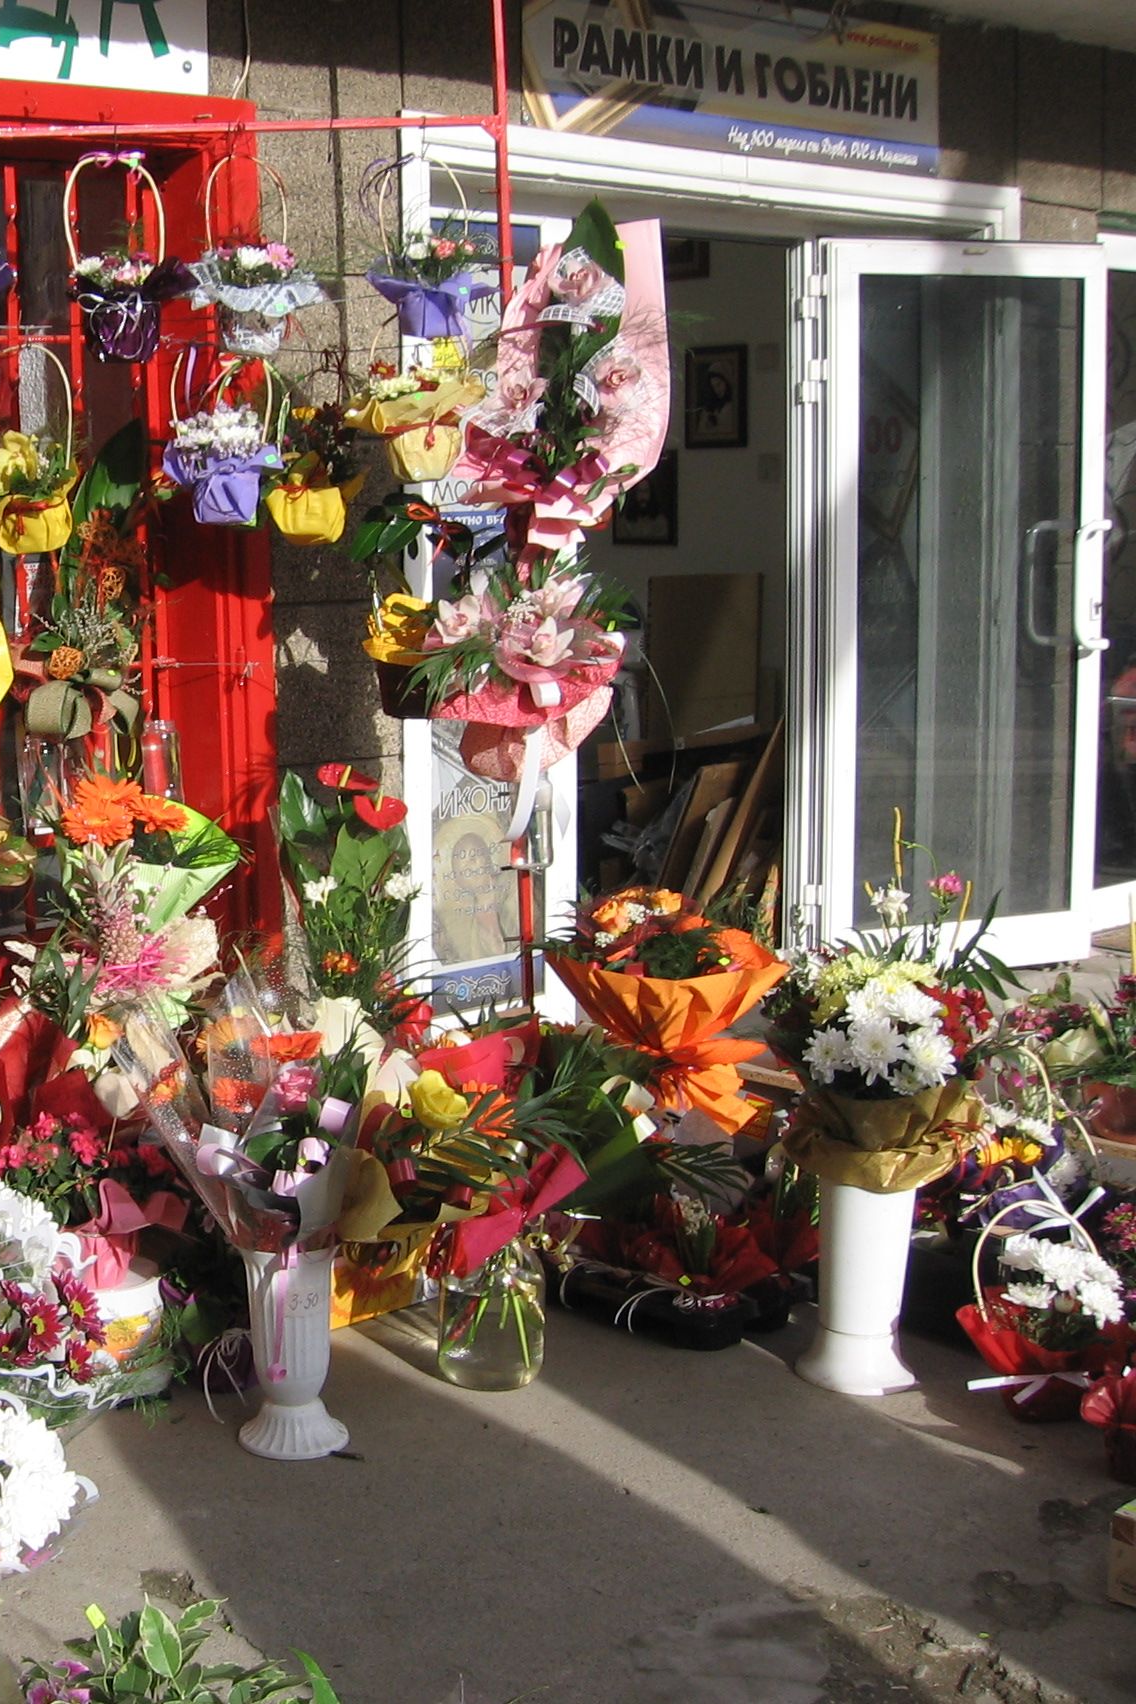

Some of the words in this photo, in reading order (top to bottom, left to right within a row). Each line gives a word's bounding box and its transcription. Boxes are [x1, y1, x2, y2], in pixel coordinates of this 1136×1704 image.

[553, 16, 704, 89] РАМКИ
[715, 45, 745, 95] И
[754, 52, 918, 121] ГОБЛЕНИ
